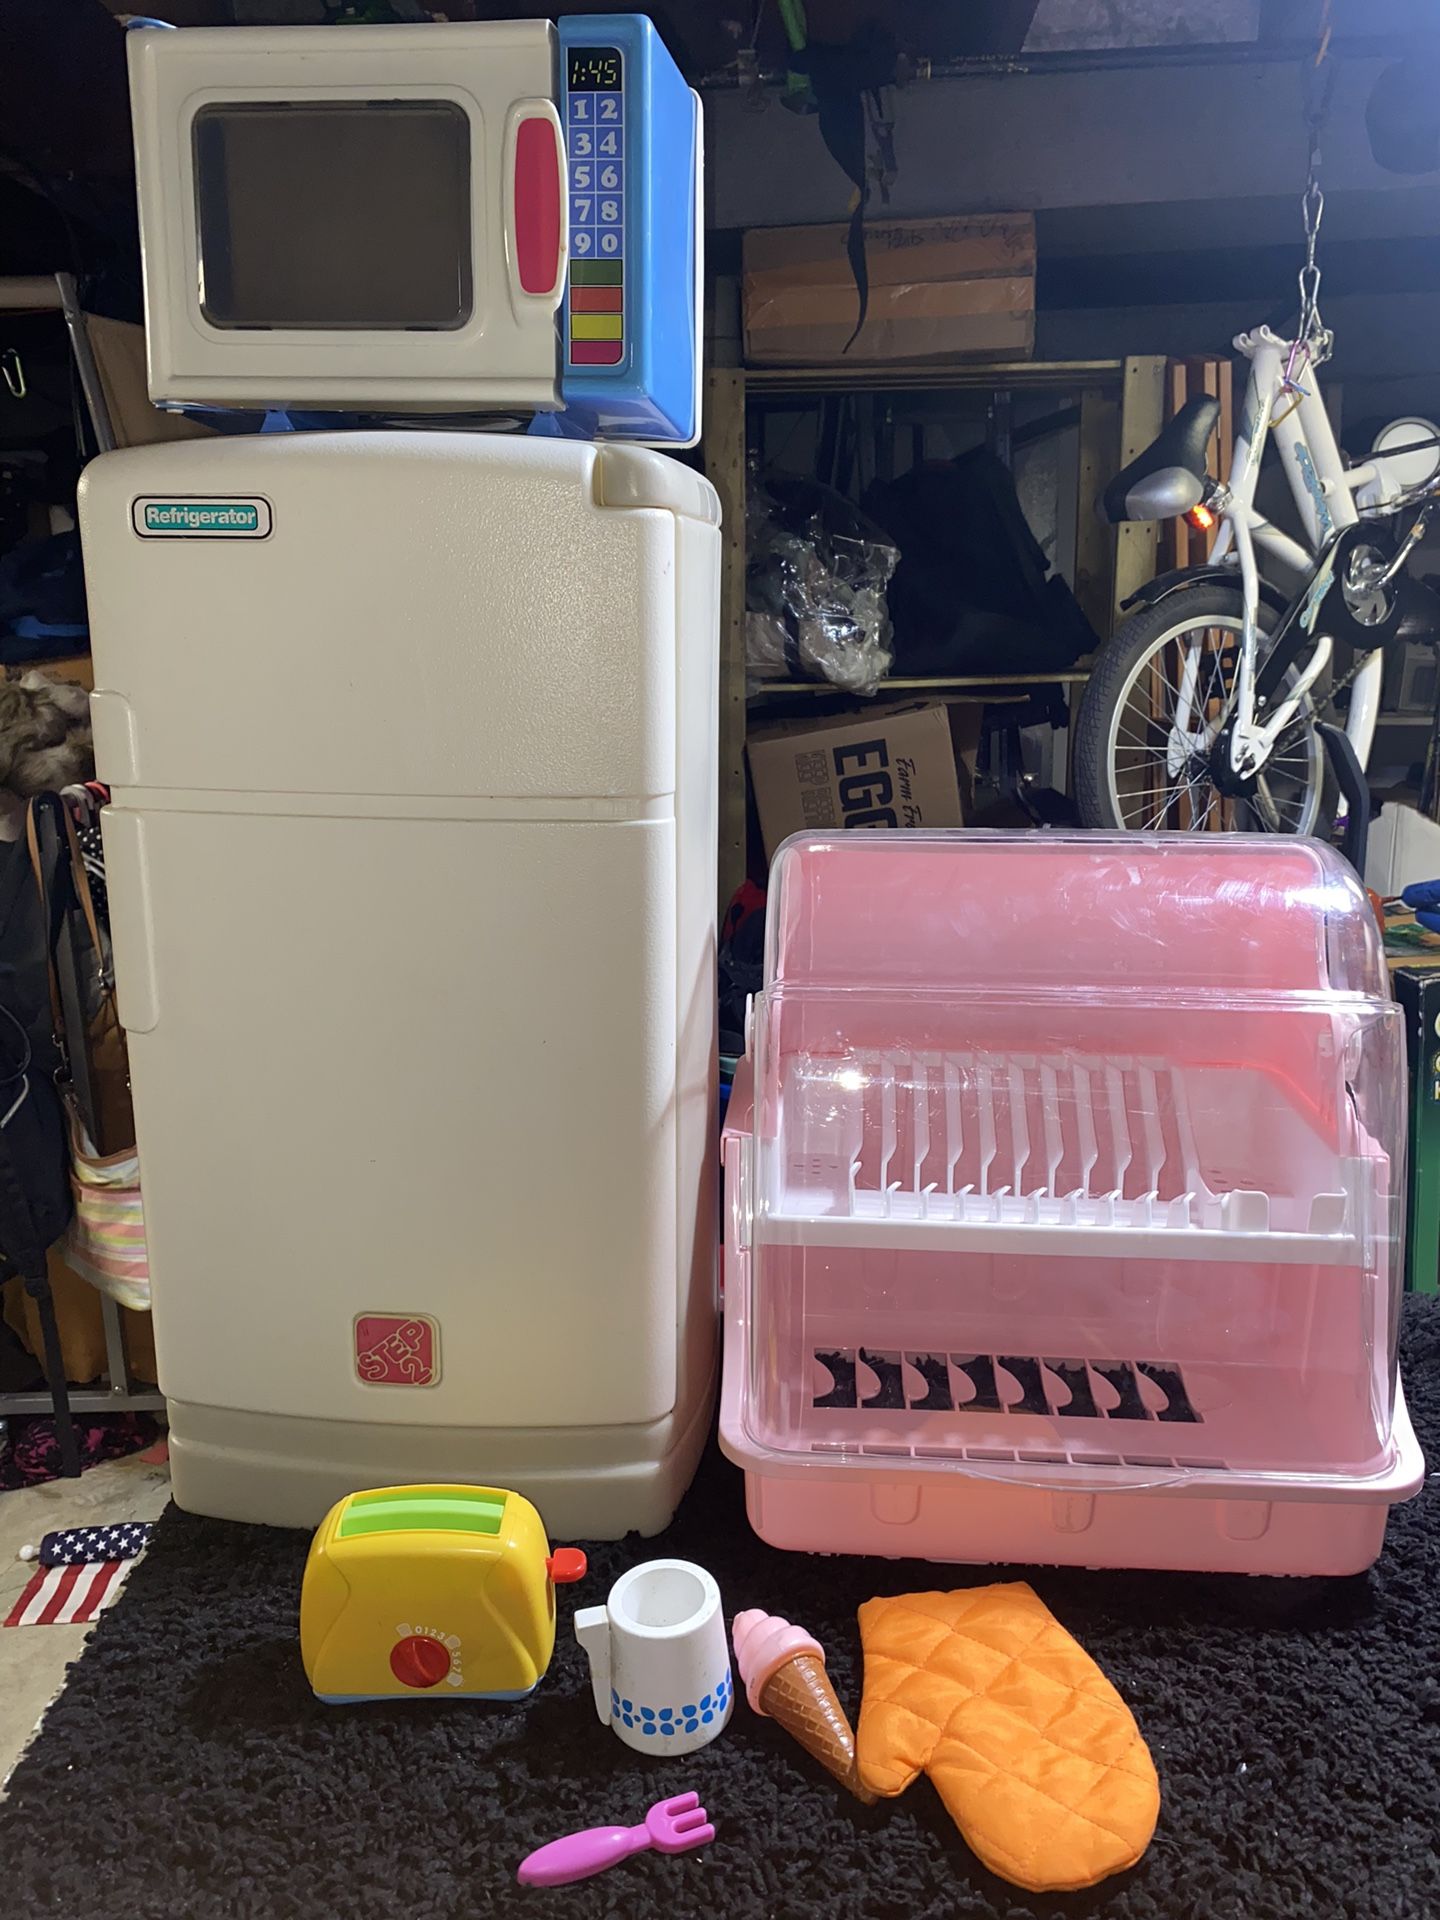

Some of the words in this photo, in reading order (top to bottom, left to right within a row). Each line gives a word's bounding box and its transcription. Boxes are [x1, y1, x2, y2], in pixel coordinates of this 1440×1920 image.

[572, 59, 617, 84] 1:45
[146, 507, 255, 527] Refrigerator
[896, 758, 916, 801] Farm
